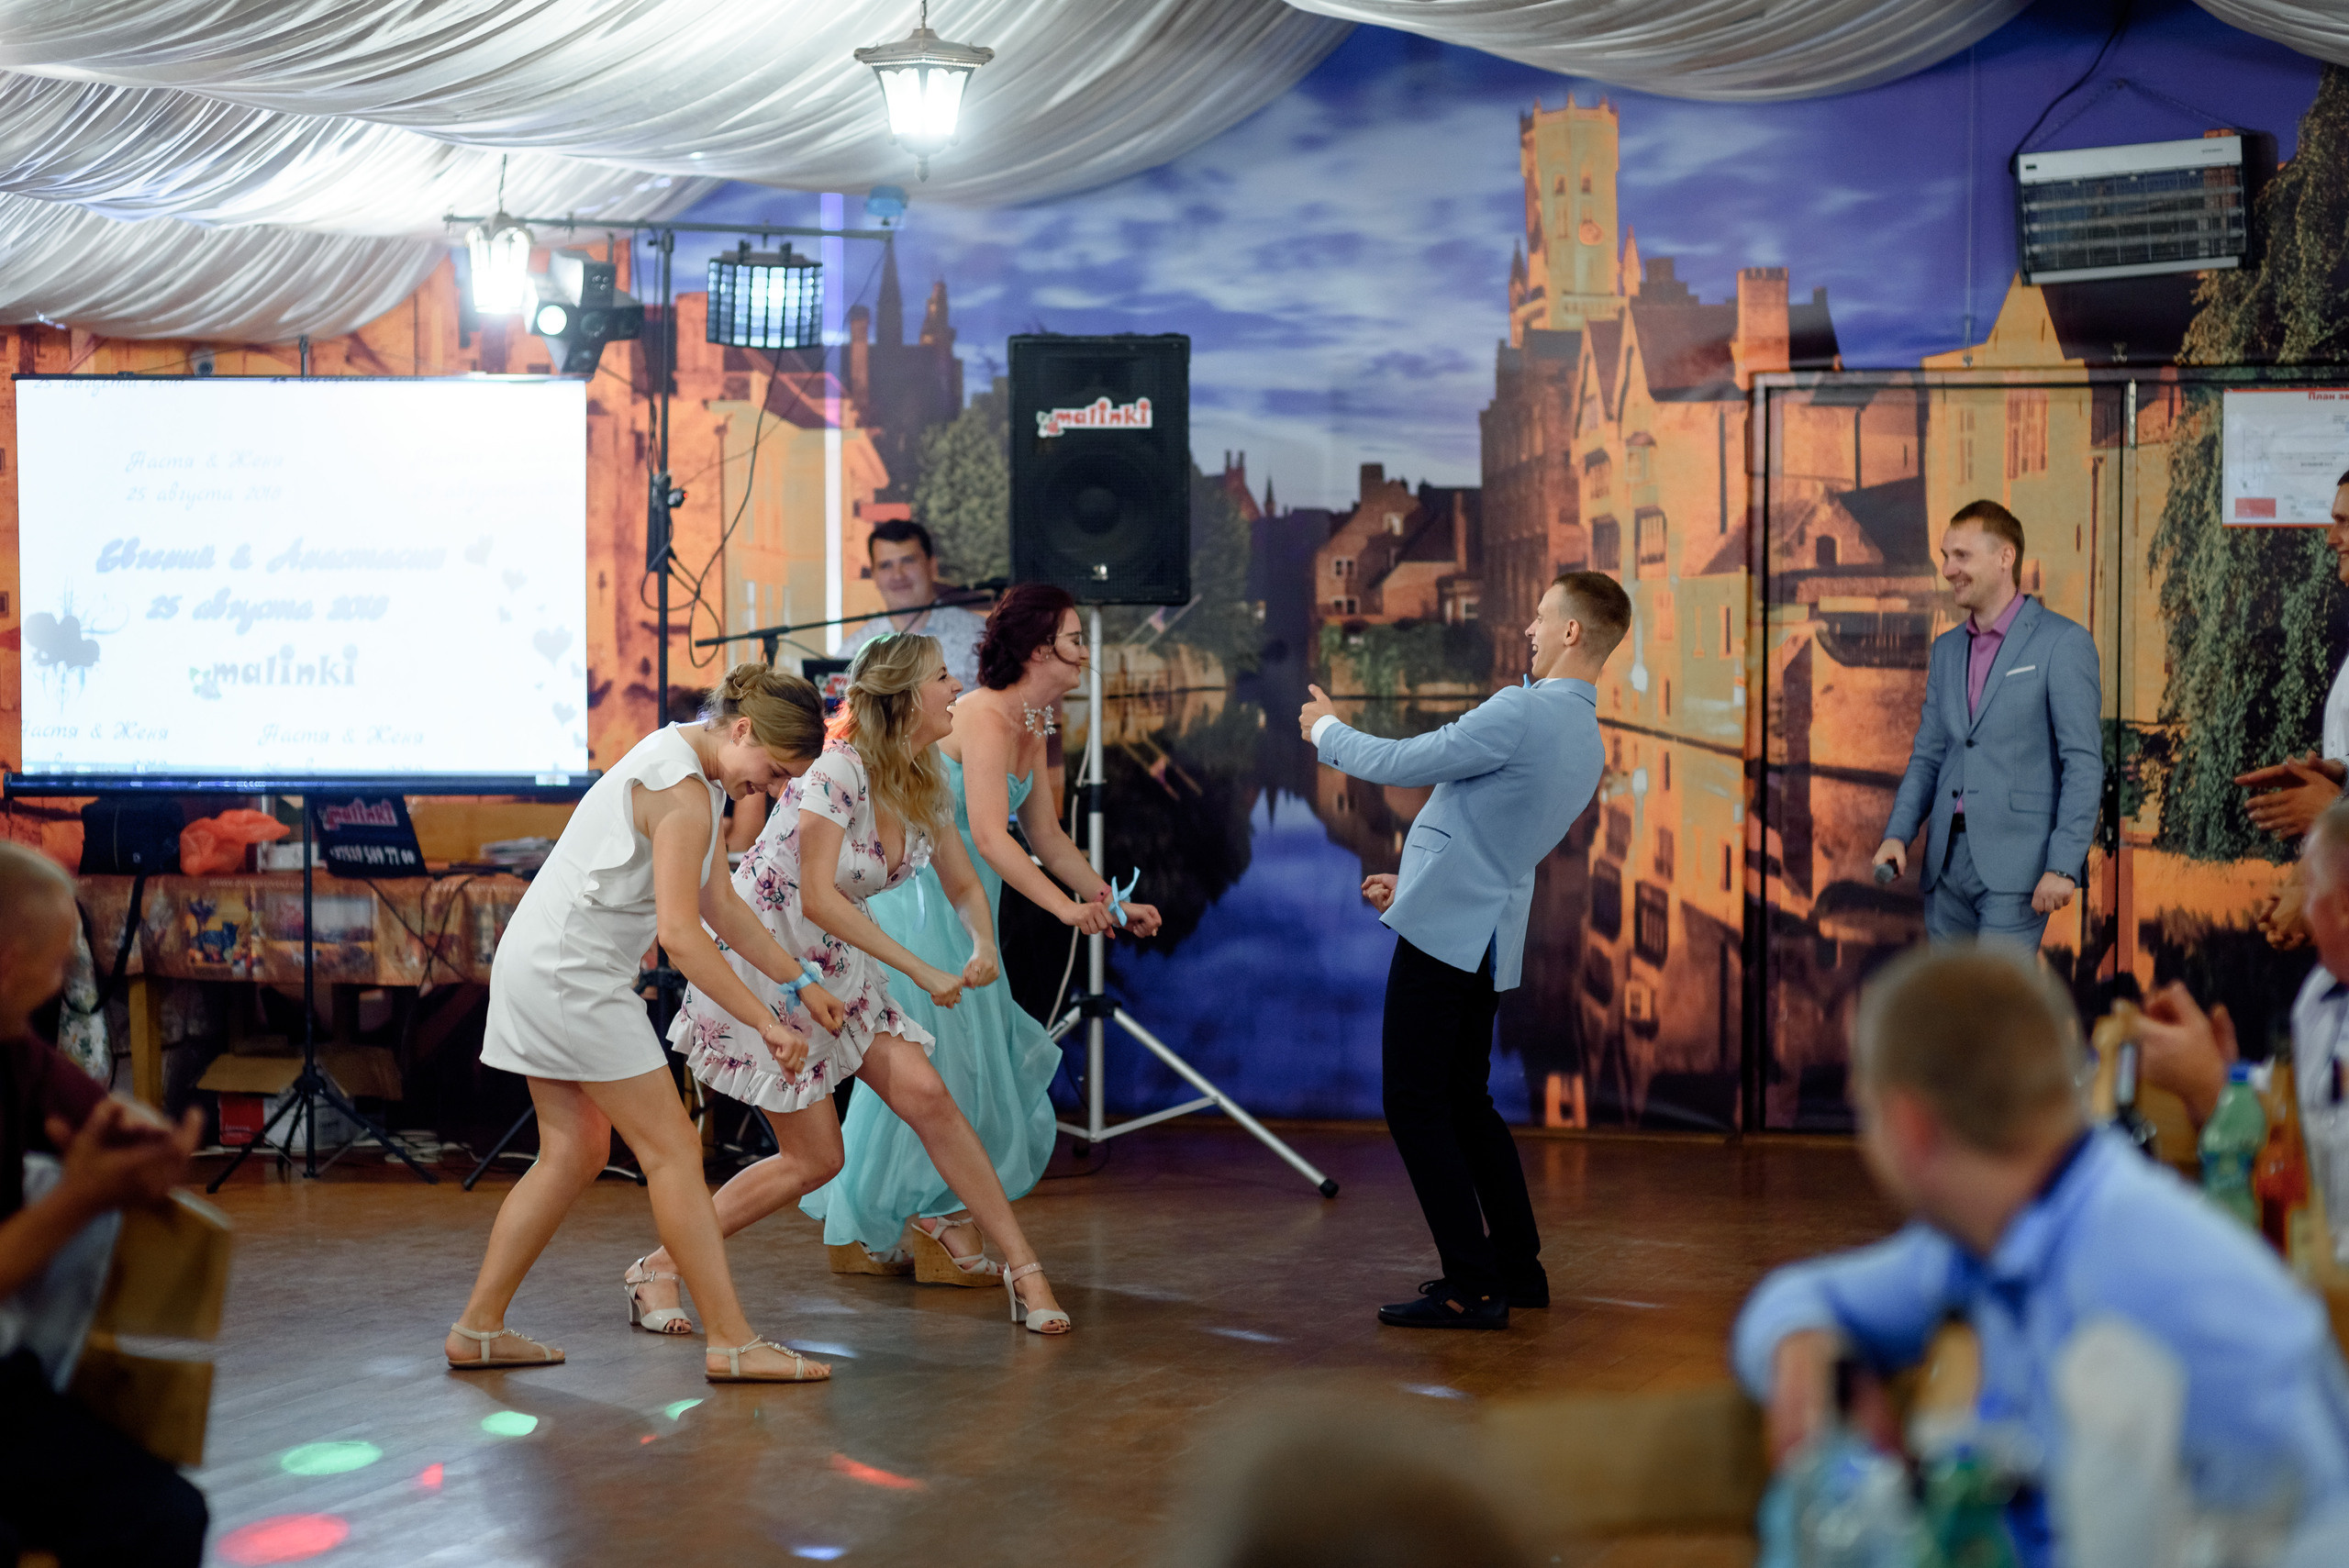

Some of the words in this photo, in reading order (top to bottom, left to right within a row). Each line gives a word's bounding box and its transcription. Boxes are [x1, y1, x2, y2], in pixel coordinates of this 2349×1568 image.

[2308, 391, 2335, 401] План
[1054, 399, 1150, 426] malinki
[125, 450, 195, 473] Настя
[228, 450, 284, 470] Женя
[125, 484, 147, 502] 25
[156, 481, 234, 510] августа
[145, 593, 183, 621] 25
[192, 585, 314, 635] августа
[210, 643, 359, 686] malinki
[113, 720, 169, 741] Женя
[257, 722, 330, 747] Настя
[367, 724, 425, 745] Женя
